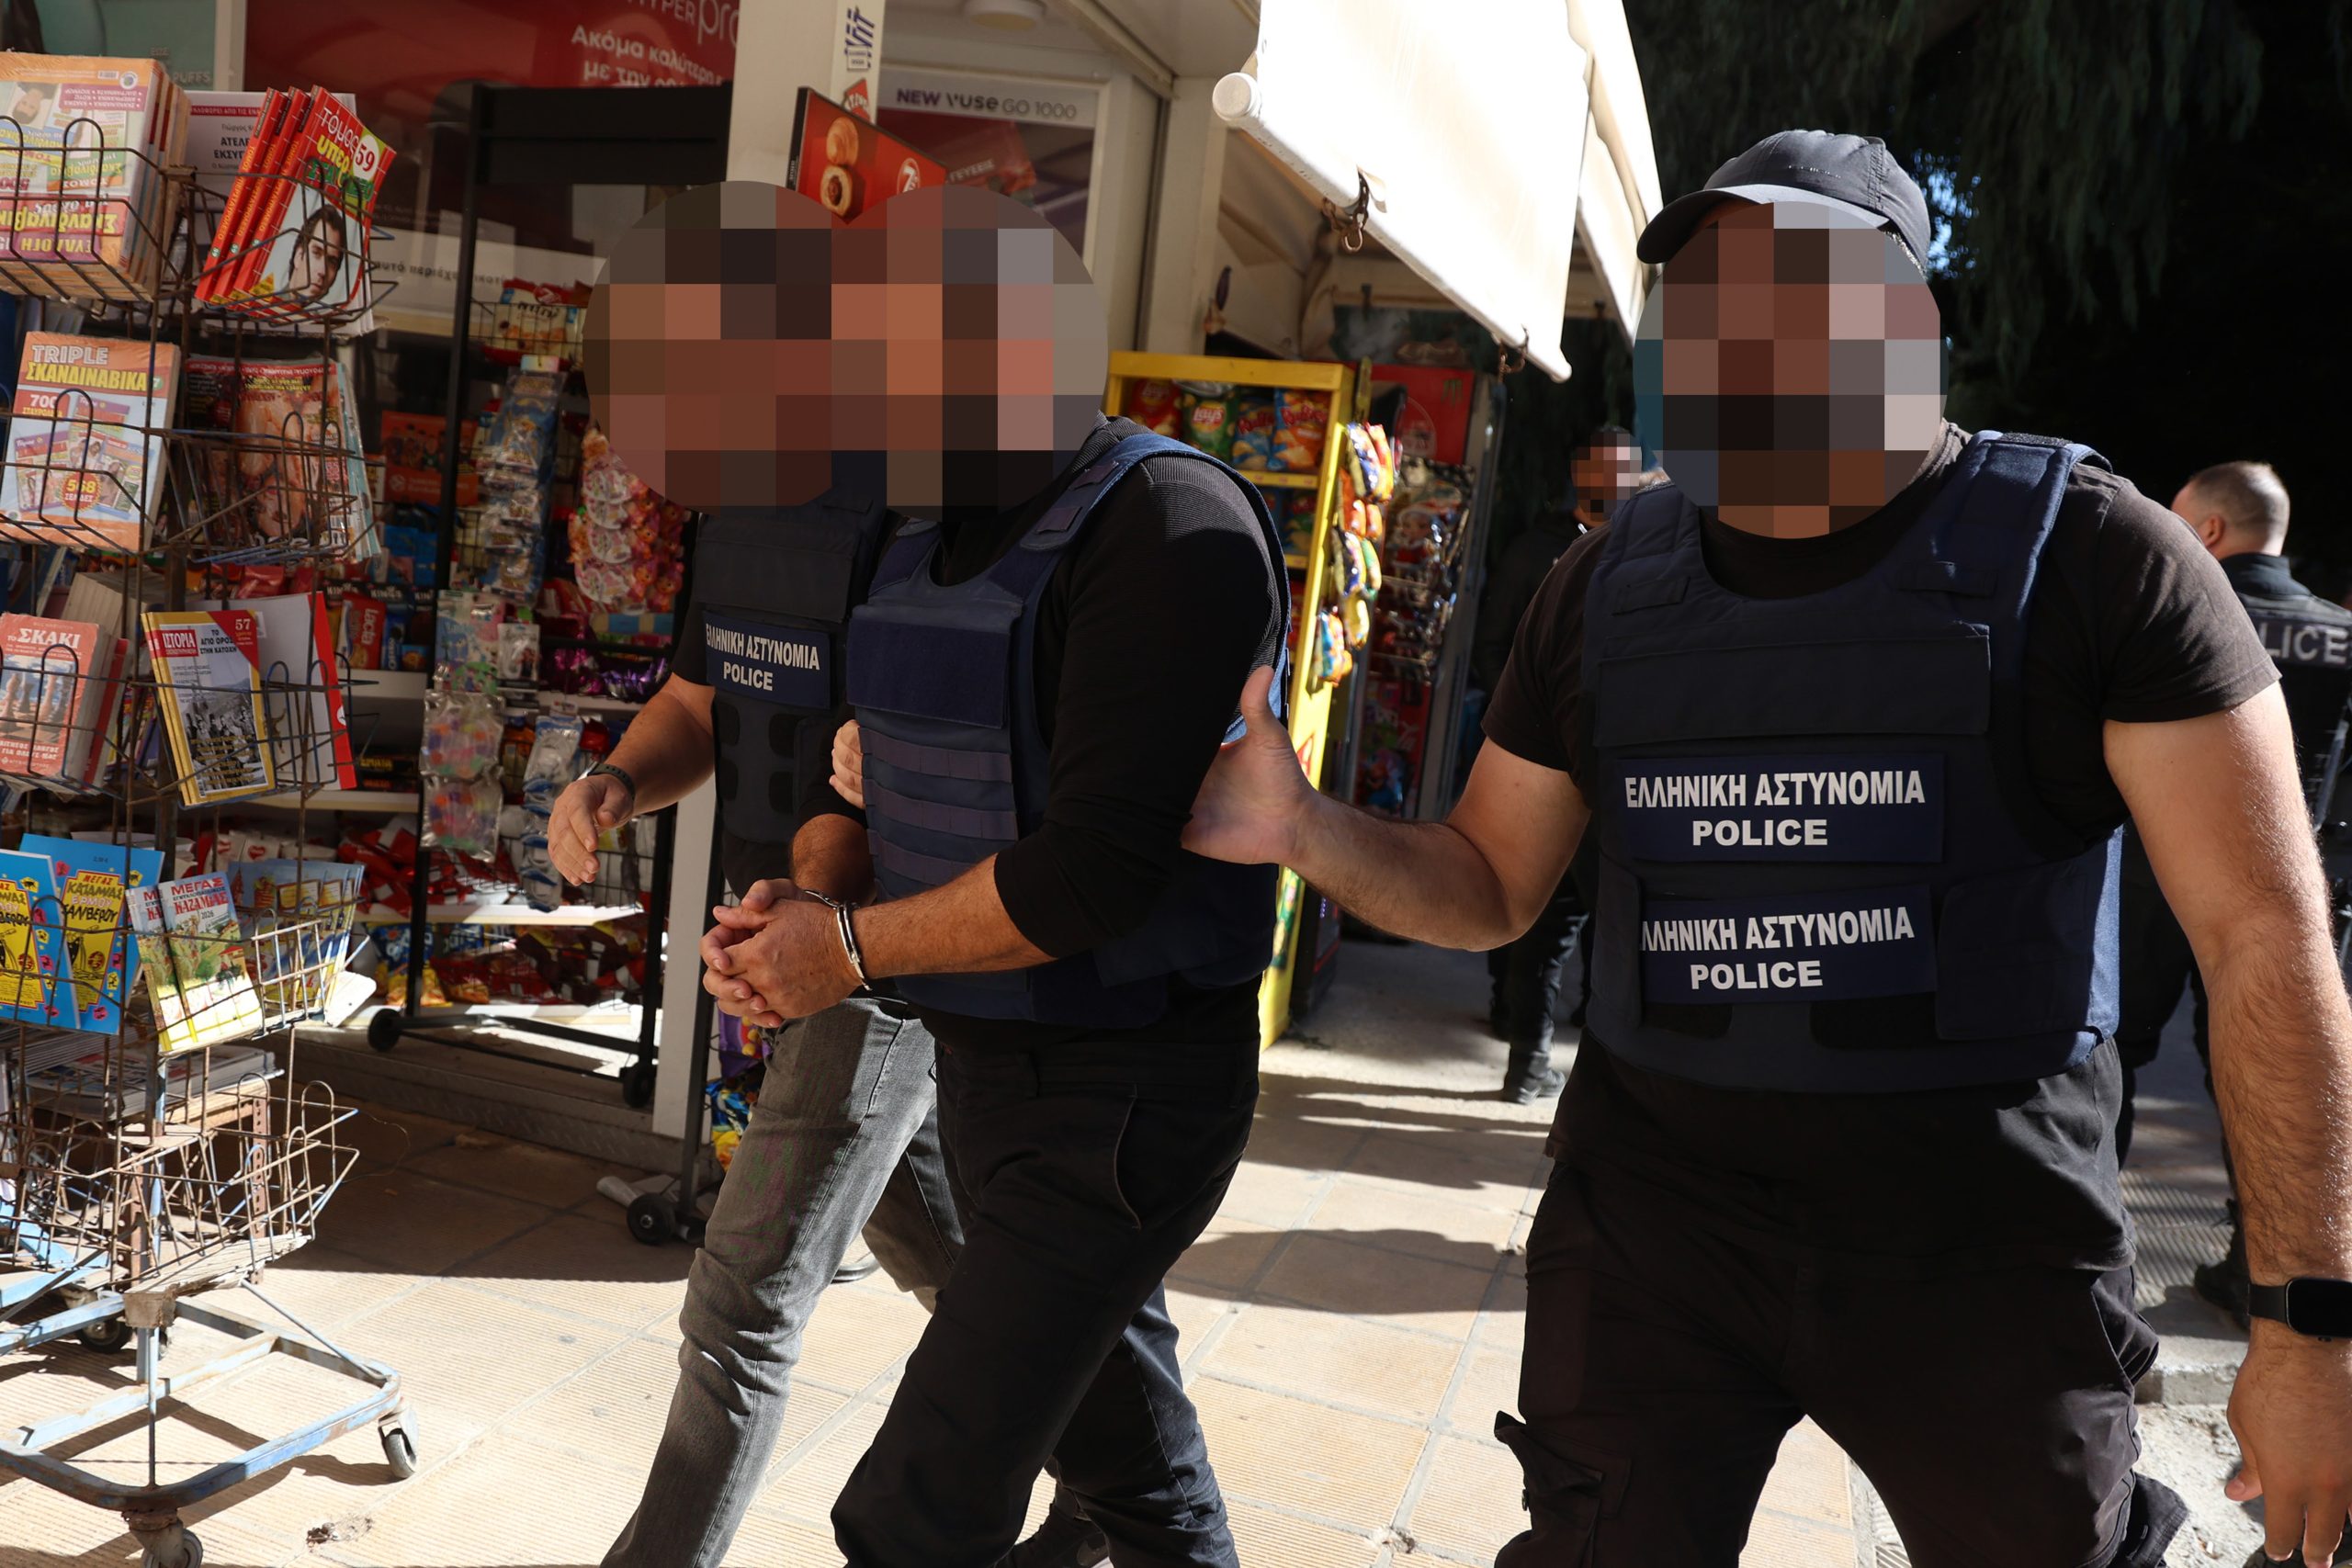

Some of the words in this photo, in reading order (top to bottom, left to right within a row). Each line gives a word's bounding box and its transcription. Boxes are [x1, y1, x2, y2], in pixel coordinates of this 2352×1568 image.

[571, 24, 644, 59] Ακόμα
[583, 60, 610, 81] με
[897, 88, 941, 106] NEW
[1002, 98, 1030, 115] GO
[1035, 101, 1078, 119] 1000
[316, 135, 351, 188] υπερ
[355, 143, 375, 172] 59
[31, 344, 109, 366] TRIPLE
[25, 361, 147, 391] ΣΚΑΝΔΙΝΑΒΙΚΑ
[17, 627, 82, 649] ΣΚΑΚΙ
[235, 618, 251, 631] 57
[162, 632, 197, 649] ΙΣΤΟΡΙΑ
[216, 636, 233, 644] ΟΡΟΣ
[706, 623, 744, 657] ΕΛΛΗΝΙΚΗ
[746, 635, 820, 671] ΑΣΤΥΝΟΜΙΑ
[2259, 622, 2348, 663] LICE
[723, 660, 774, 691] POLICE
[1625, 774, 1746, 808] ΕΛΛΗΝΙΚΗ
[1755, 771, 1925, 806] ΑΣΤΥΝΟΜΙΑ
[1692, 818, 1827, 846] POLICE
[83, 874, 113, 886] ΜΕΓΑΣ
[171, 876, 224, 896] ΜΕΓΑΣ
[72, 896, 112, 908] ΕΡΜΟΥ
[173, 891, 229, 915] ΚΑΖΑΜΙΑΣ
[200, 909, 214, 919] 2026
[1640, 919, 1737, 952] ΛΛΗΝΙΚΗ
[1746, 907, 1915, 949] ΑΣΤΥΝΟΜΙΑ
[1690, 960, 1823, 989] POLICE
